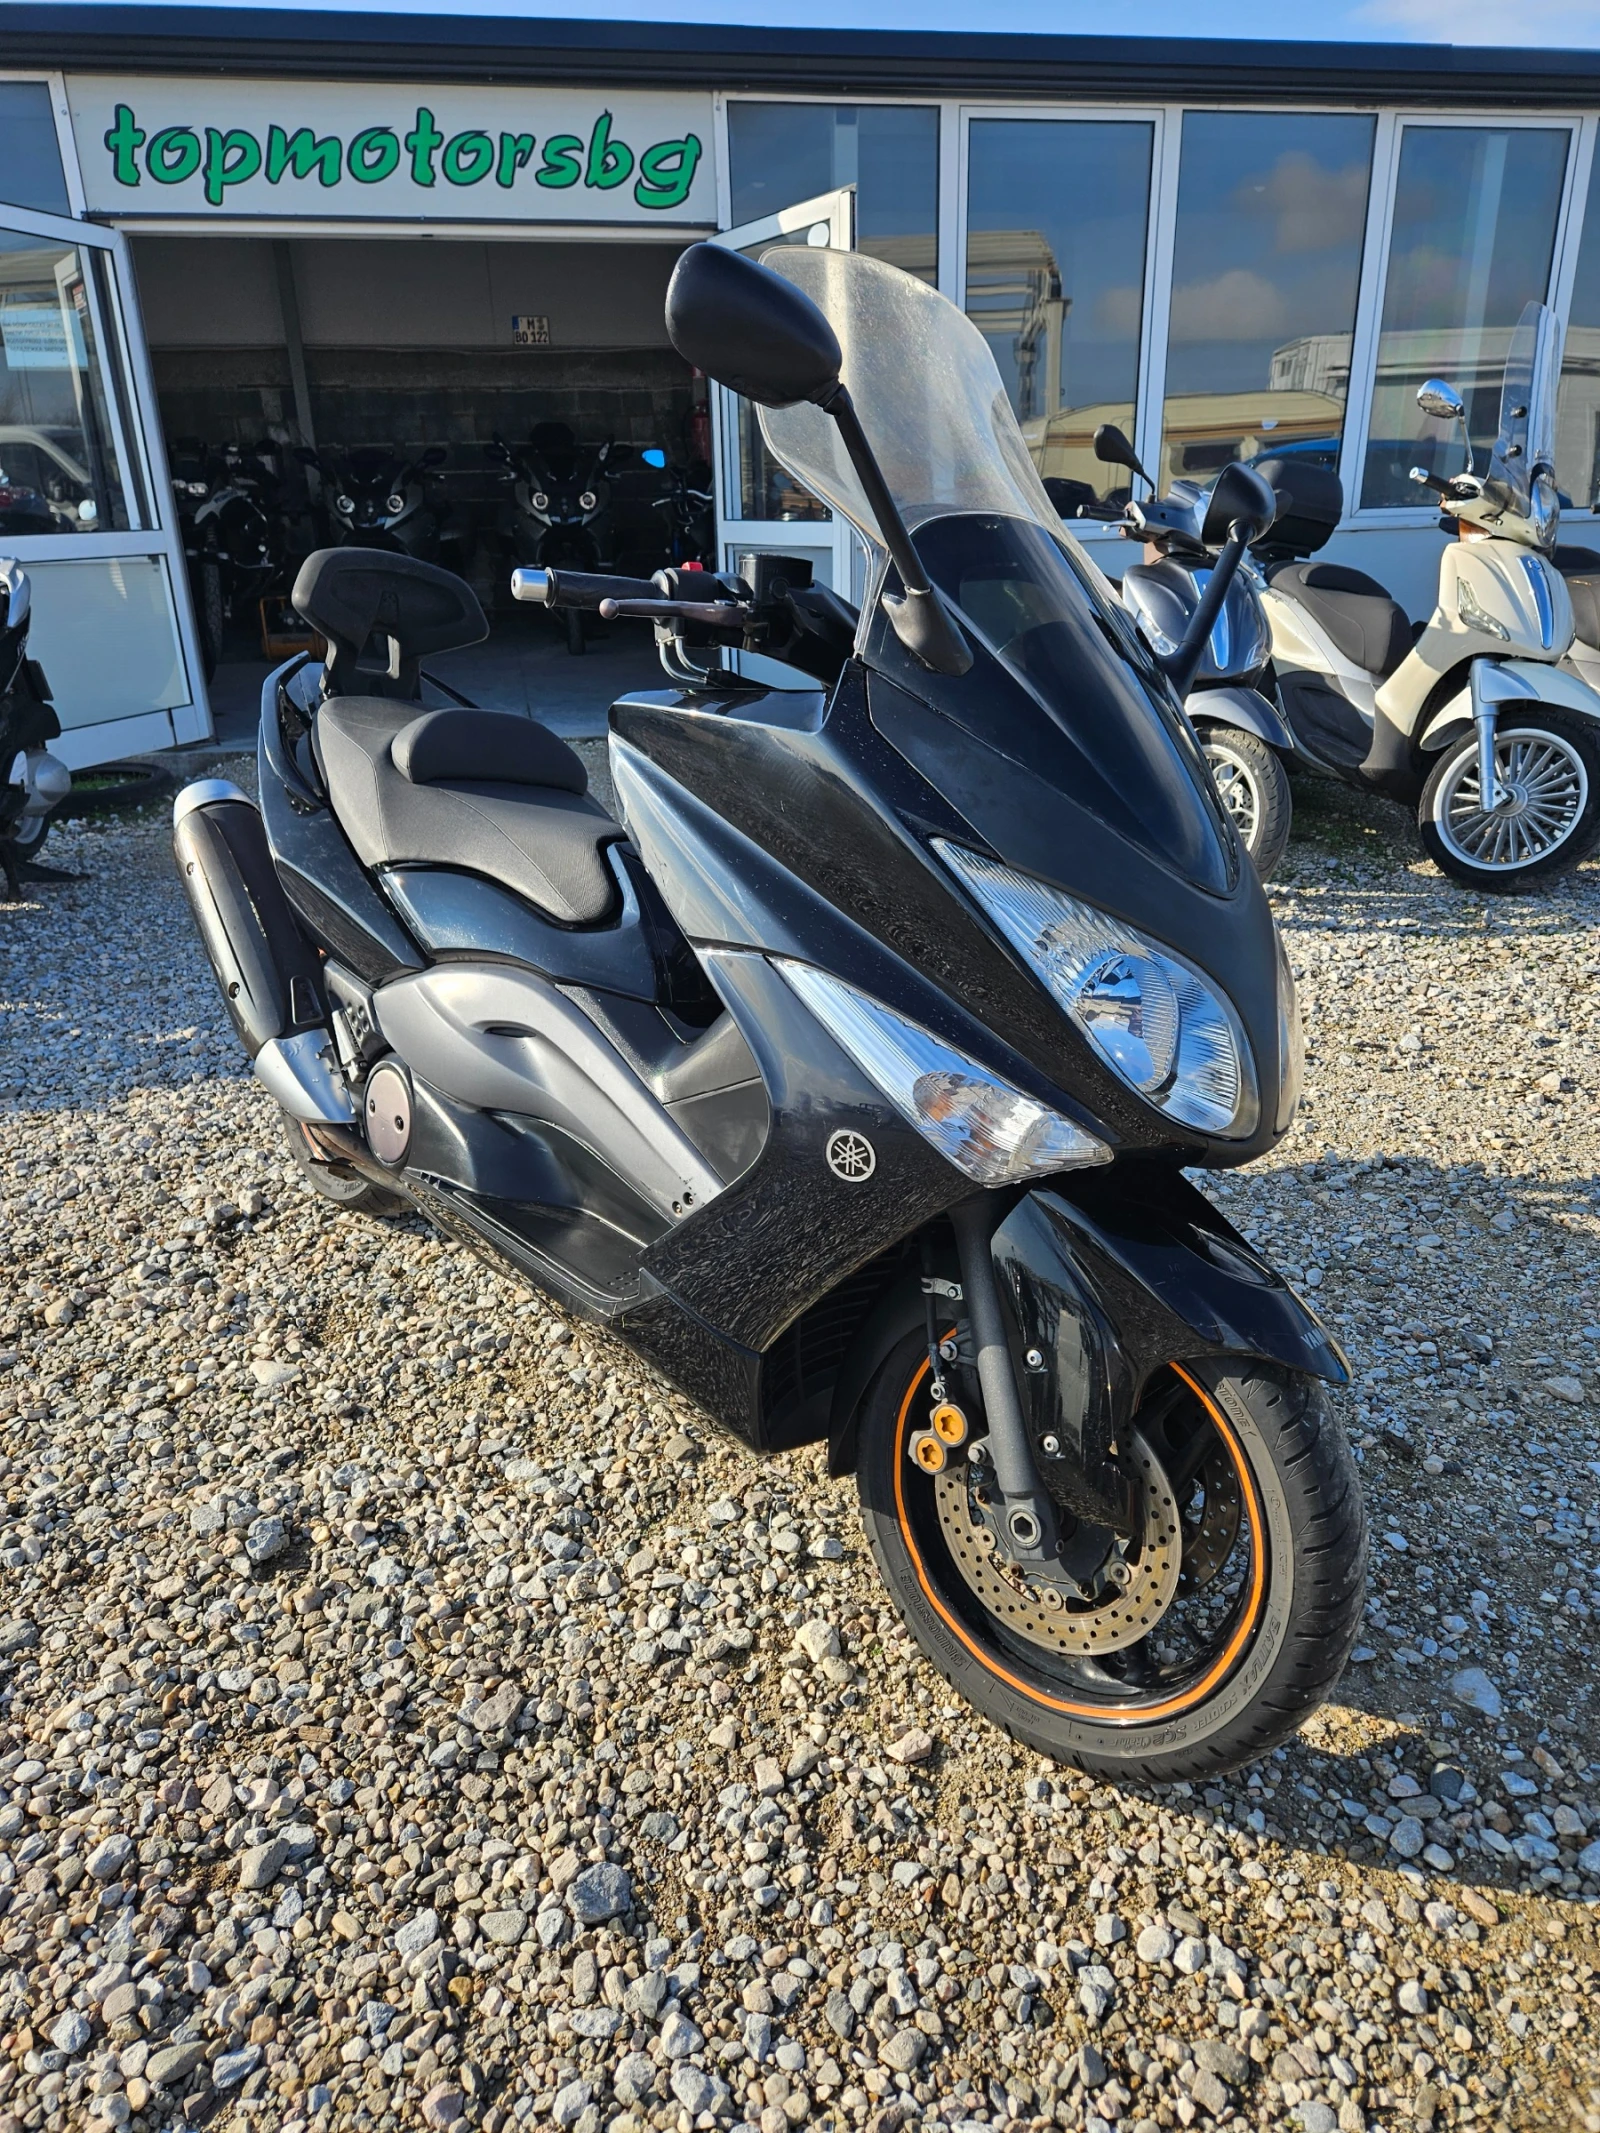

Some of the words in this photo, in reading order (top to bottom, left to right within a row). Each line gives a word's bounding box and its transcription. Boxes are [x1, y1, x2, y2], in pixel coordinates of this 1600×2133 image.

[104, 103, 700, 209] topmotorsbg
[900, 1574, 967, 1667] BRIDGESTONE
[1192, 1691, 1238, 1731] SCOOTER
